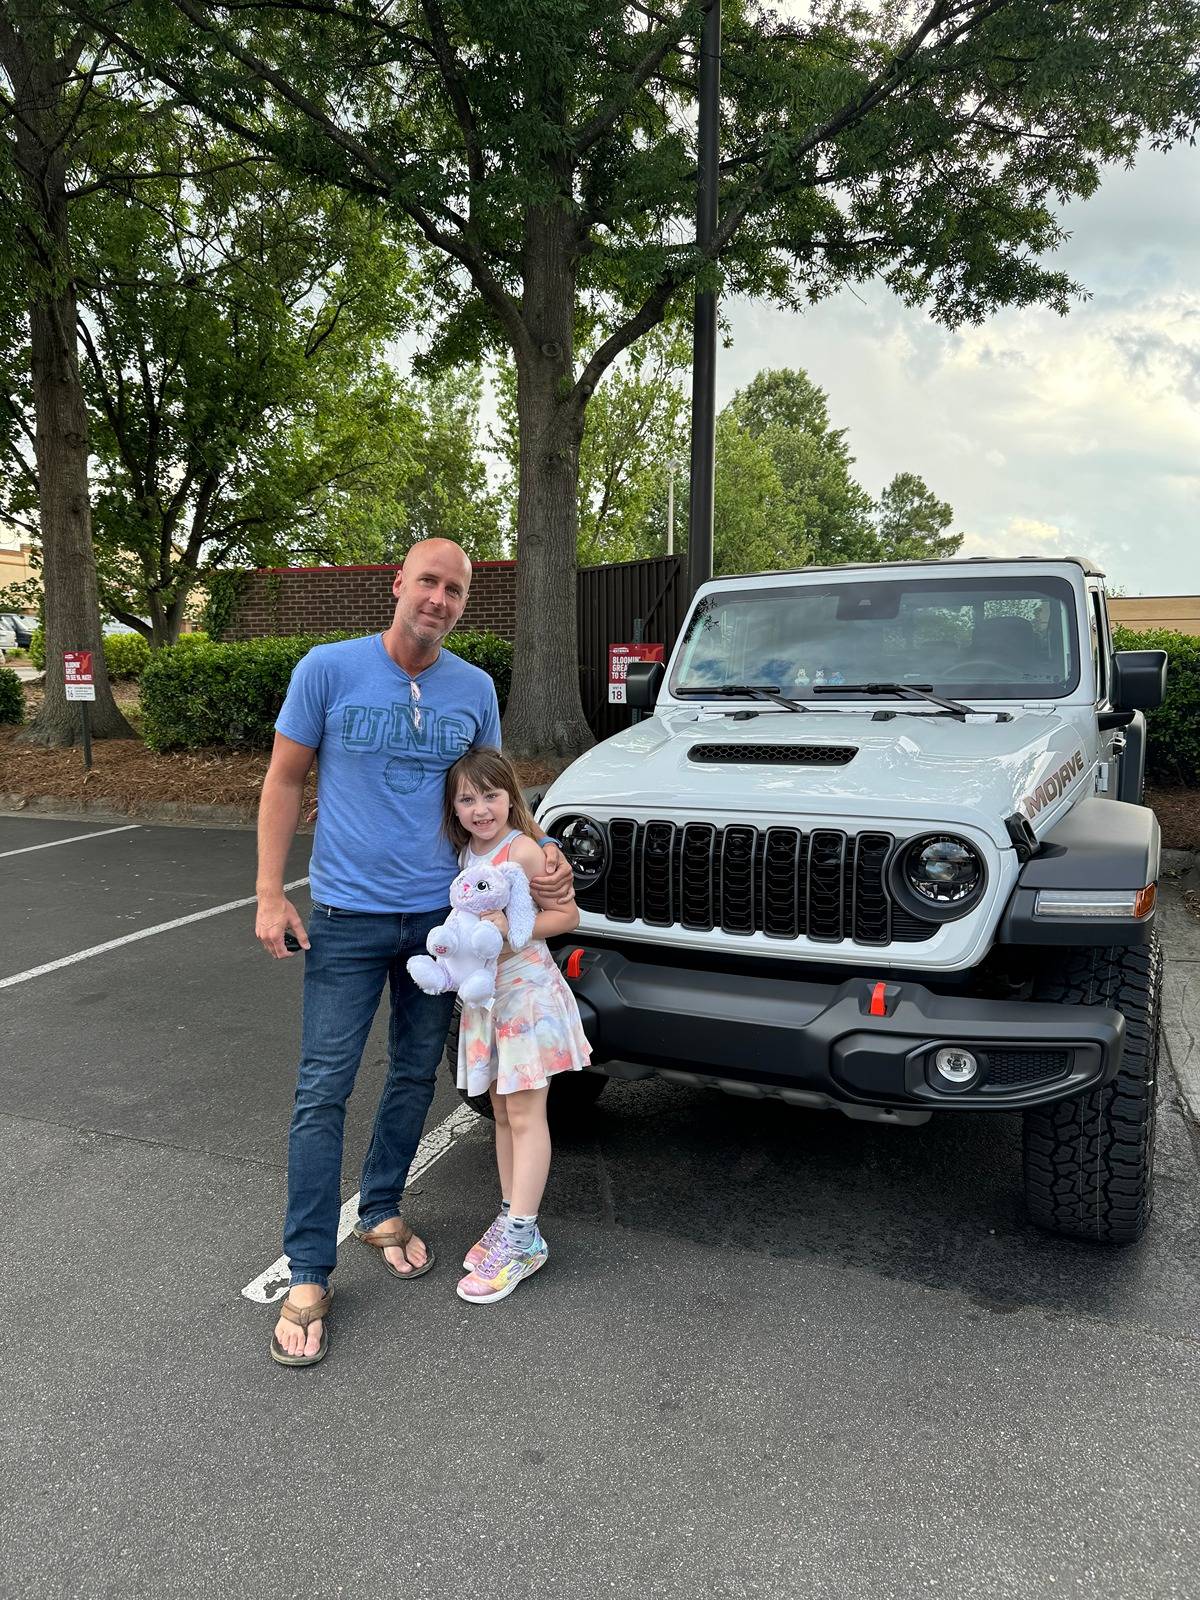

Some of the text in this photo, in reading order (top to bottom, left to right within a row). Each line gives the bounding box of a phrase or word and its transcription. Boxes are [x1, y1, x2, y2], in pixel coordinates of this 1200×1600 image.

[612, 664, 628, 672] GREA
[612, 690, 623, 700] 18
[341, 702, 472, 761] UNC
[1022, 750, 1084, 819] MOJAVE
